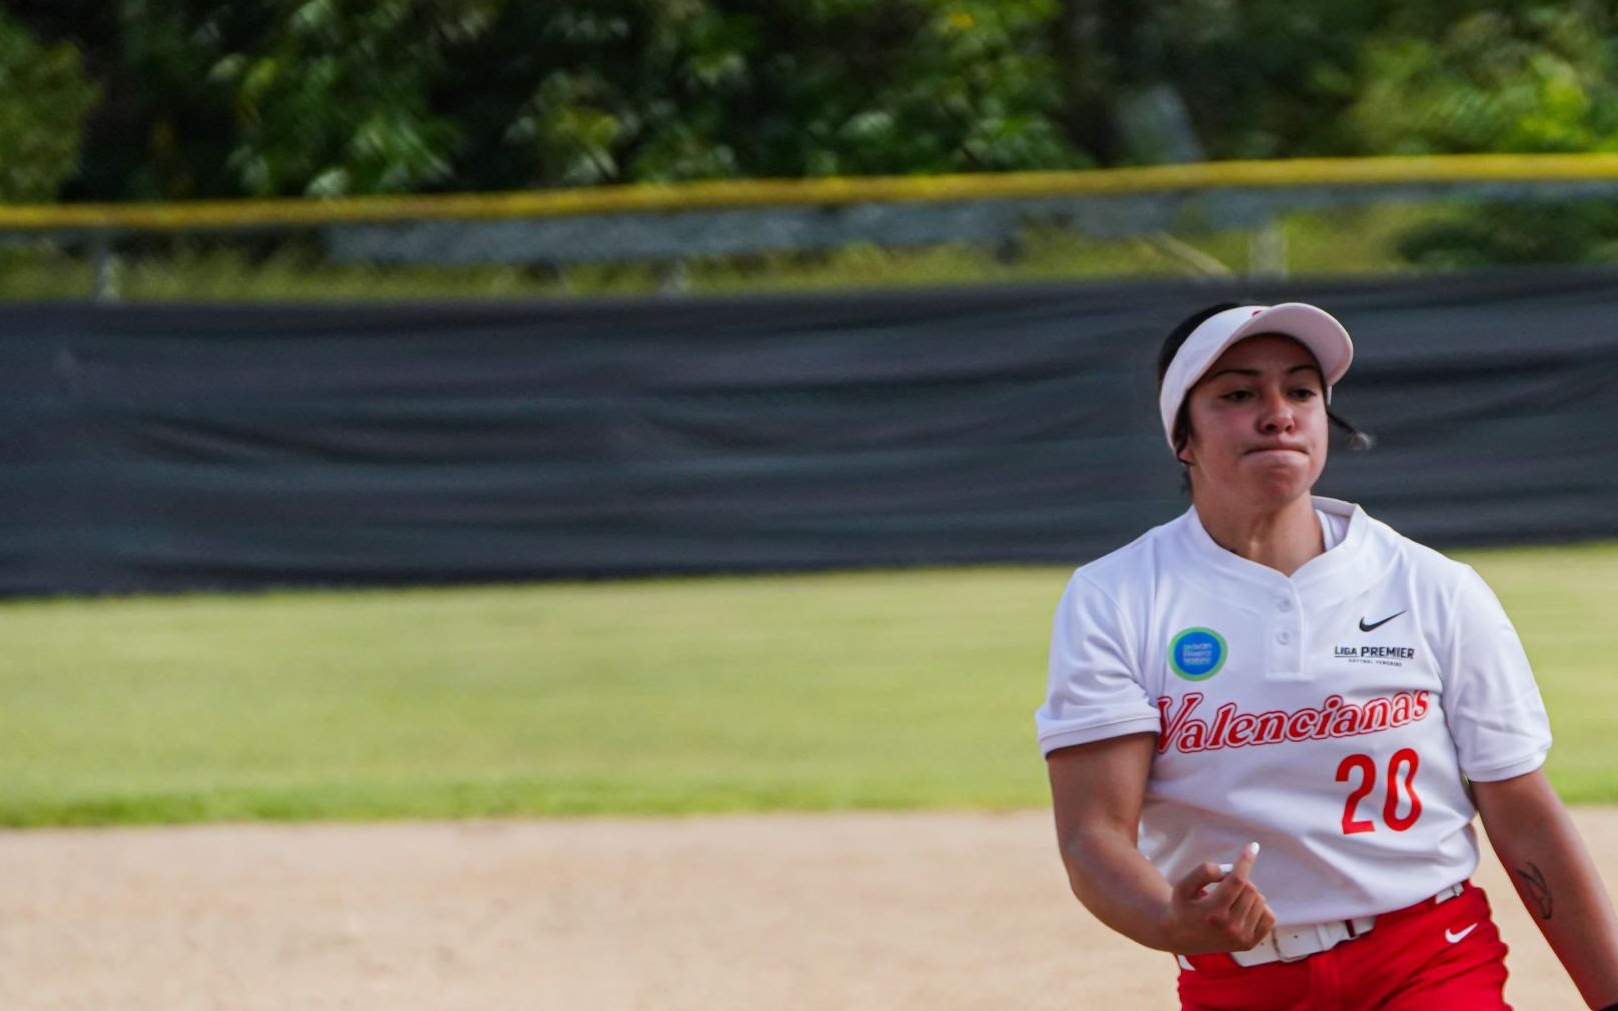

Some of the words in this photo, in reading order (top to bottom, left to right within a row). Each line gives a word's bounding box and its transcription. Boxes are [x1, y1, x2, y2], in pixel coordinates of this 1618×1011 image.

[1334, 645, 1358, 656] LIGA
[1361, 646, 1415, 660] PREMIER
[1157, 688, 1433, 754] Valencianas
[1335, 748, 1422, 834] 20
